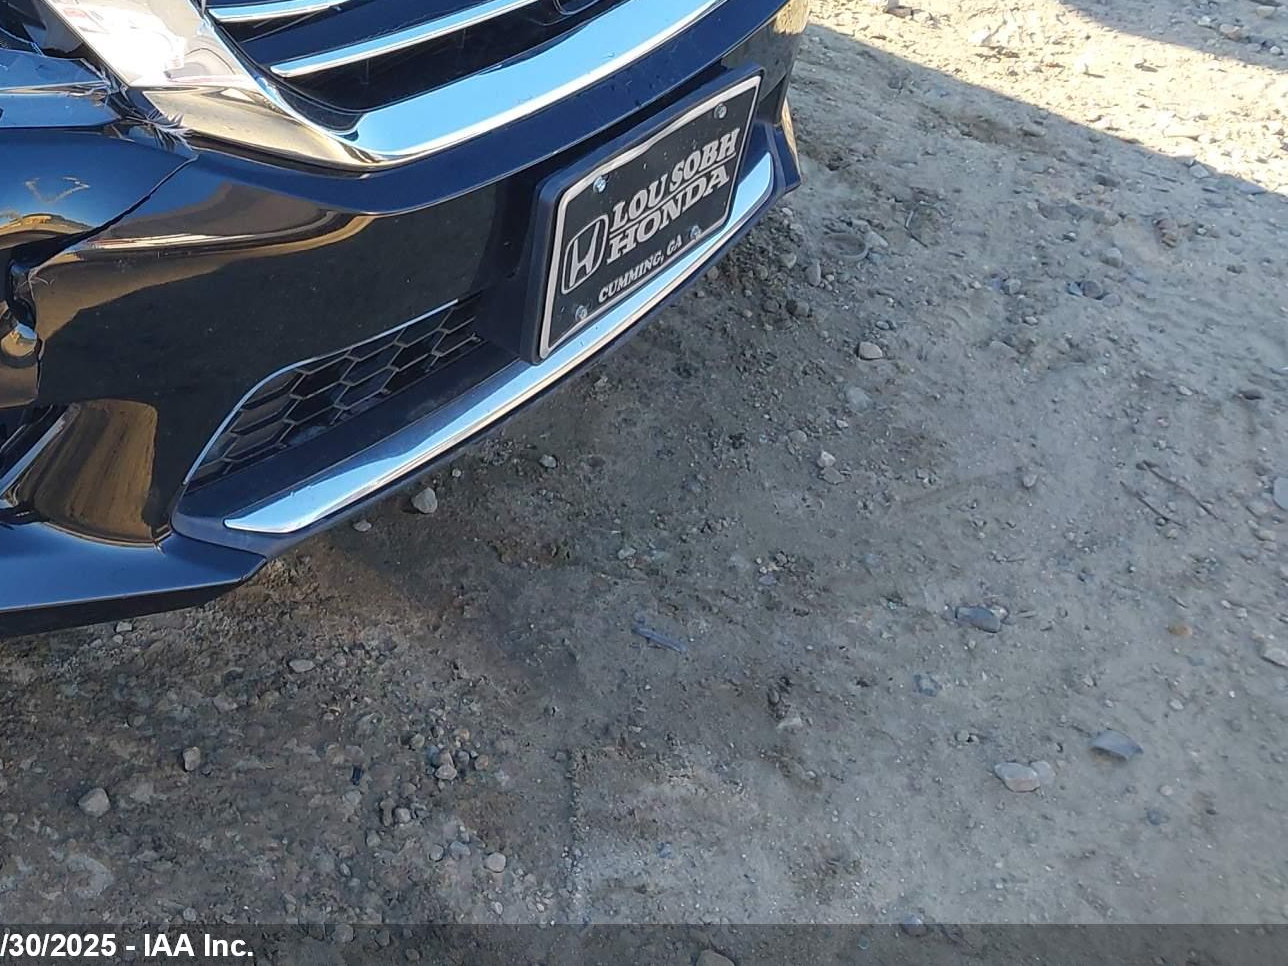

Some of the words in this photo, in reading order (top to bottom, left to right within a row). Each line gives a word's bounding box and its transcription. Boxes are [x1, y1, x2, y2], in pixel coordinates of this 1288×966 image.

[606, 165, 730, 264] HONDA
[610, 177, 665, 228] LOU
[669, 128, 741, 192] SOBH
[598, 252, 664, 302] CUMMING,
[667, 236, 683, 255] GA
